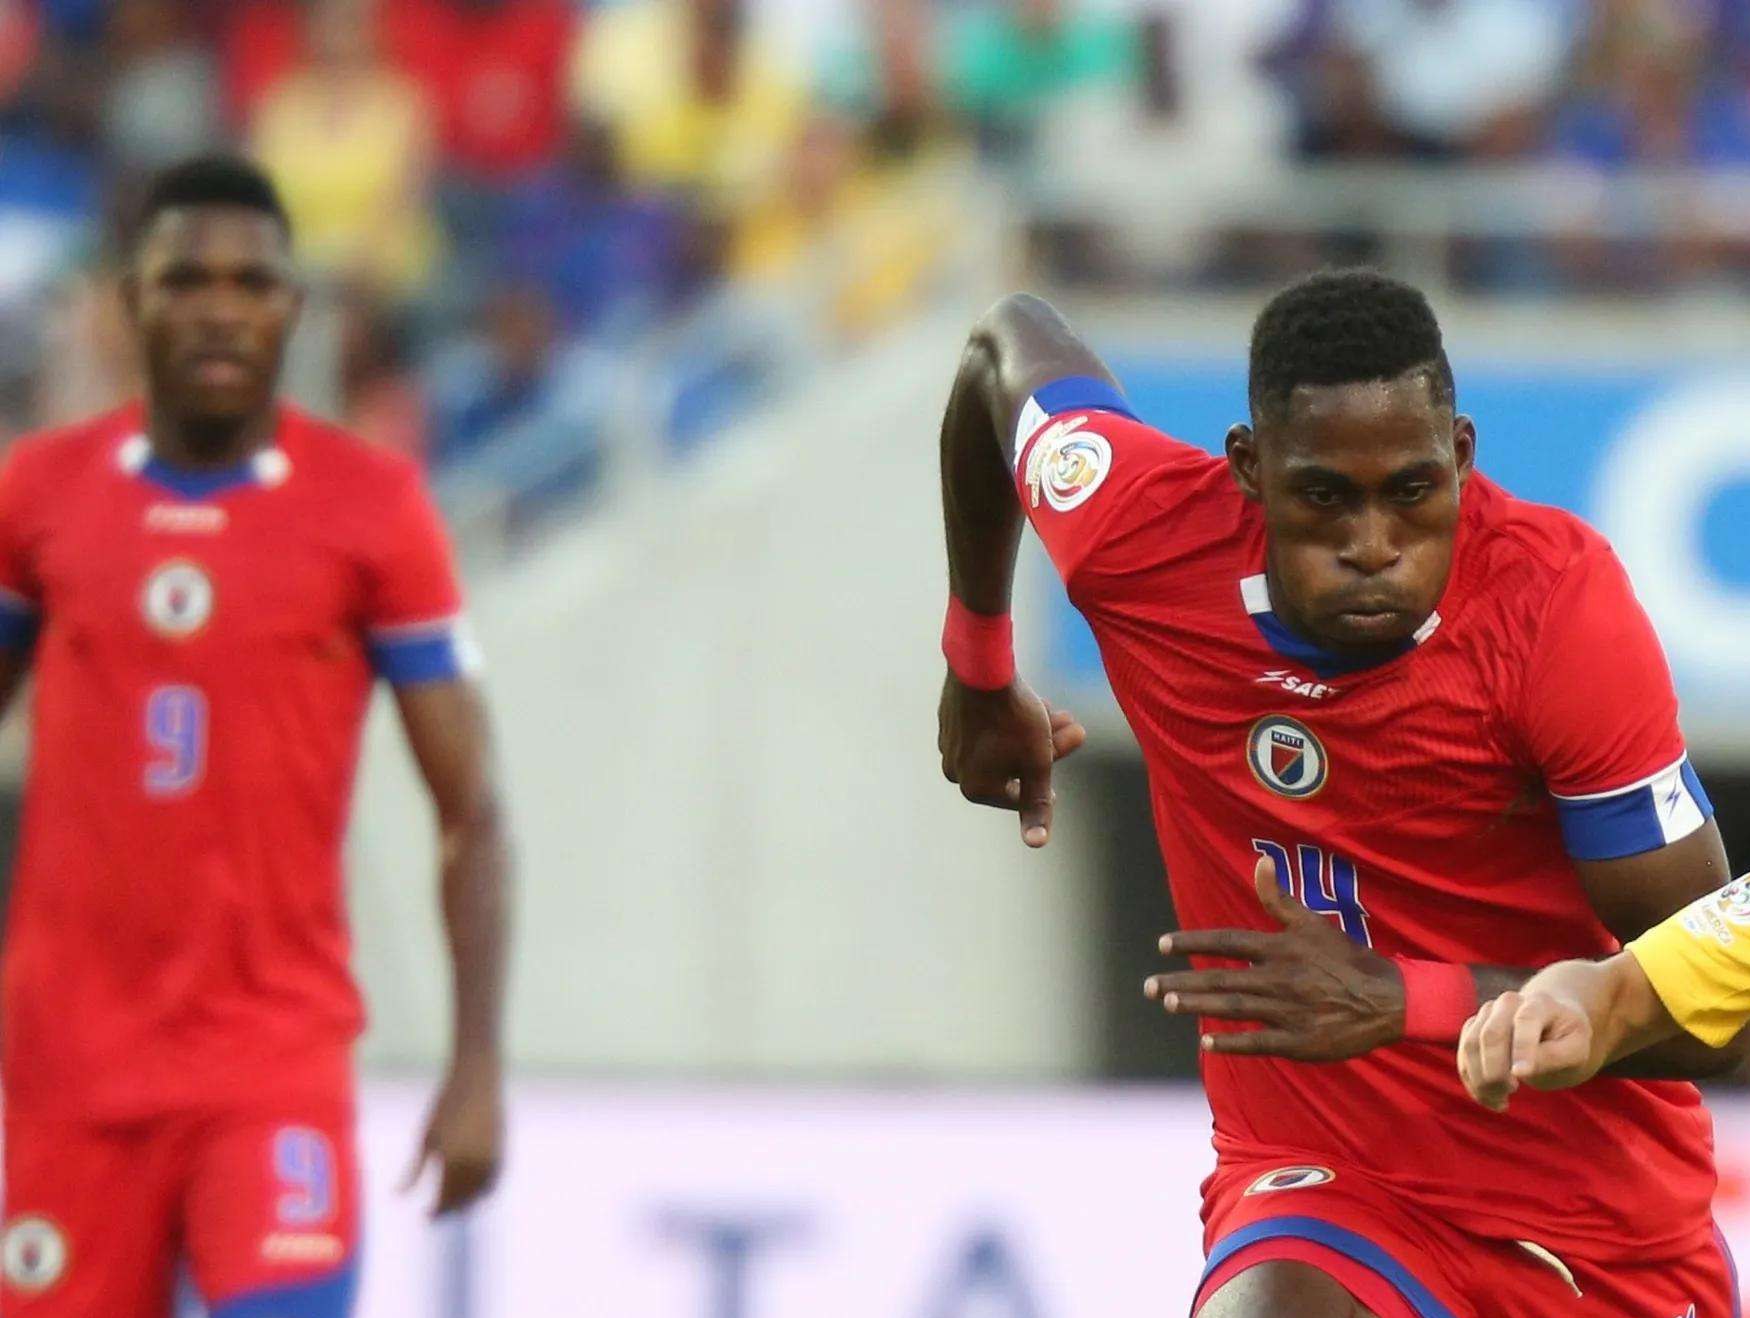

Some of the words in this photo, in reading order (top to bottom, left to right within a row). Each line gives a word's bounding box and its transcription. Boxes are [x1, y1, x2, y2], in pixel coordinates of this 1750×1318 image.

[145, 684, 210, 796] 9
[1273, 733, 1301, 746] HAITI
[273, 1126, 339, 1224] 9
